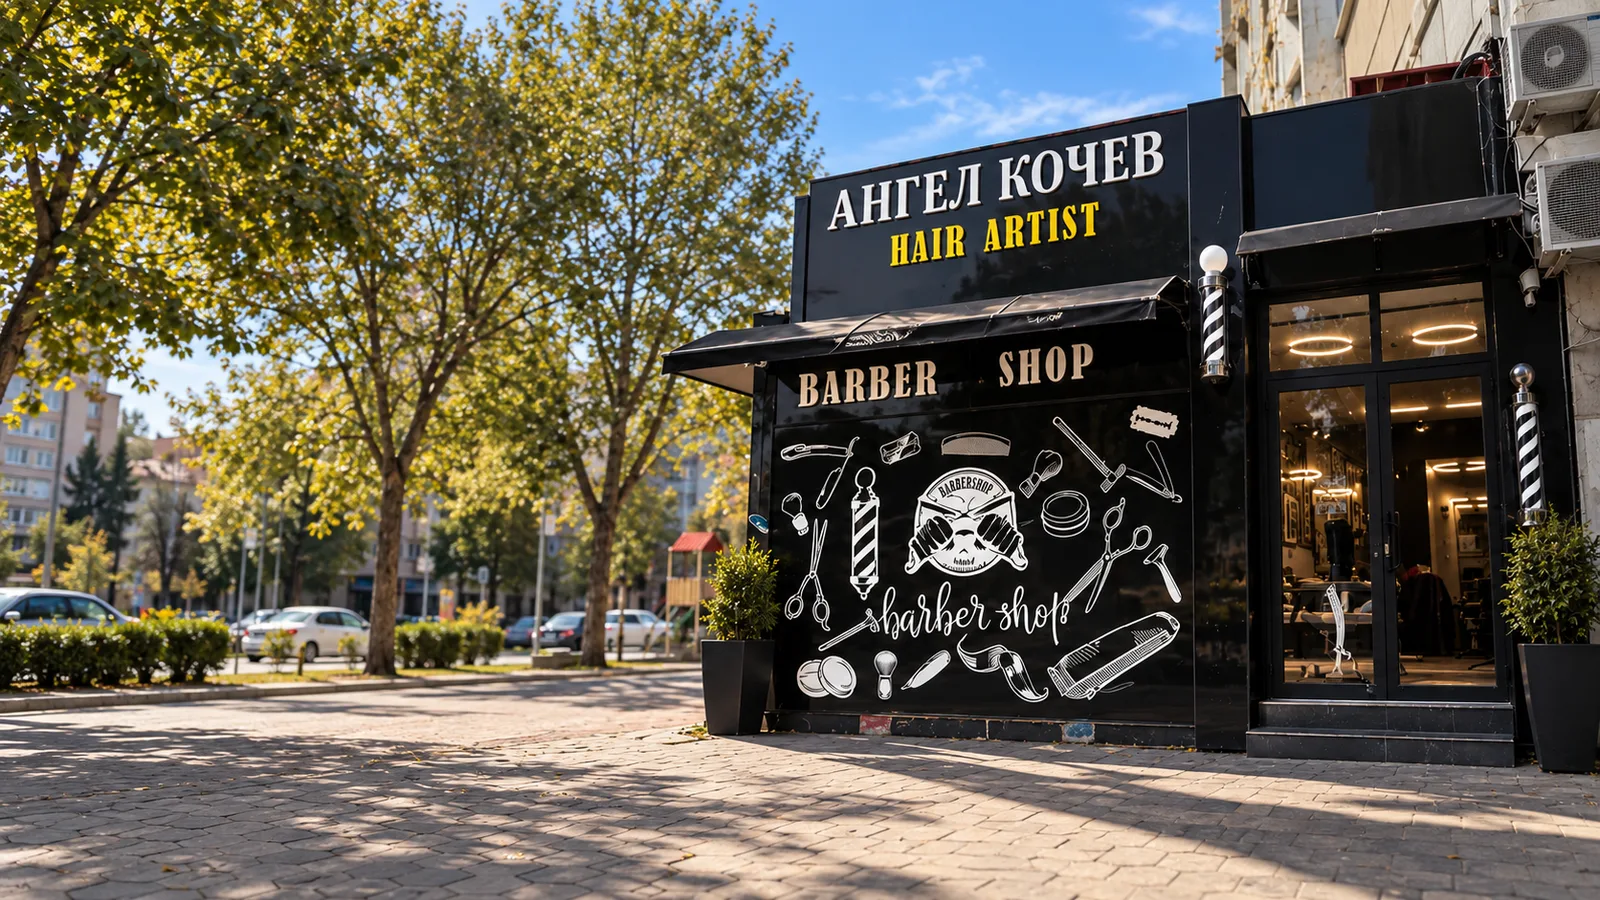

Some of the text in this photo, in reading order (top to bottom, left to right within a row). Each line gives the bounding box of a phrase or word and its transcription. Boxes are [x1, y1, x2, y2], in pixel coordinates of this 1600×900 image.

[827, 130, 1165, 231] АНГЕЛ КОЧЕВ
[889, 201, 1100, 267] HAIR ARTIST
[797, 343, 1094, 408] BARBER SHOP
[938, 476, 994, 498] BARBERSHOP
[882, 581, 1061, 646] barber shop
